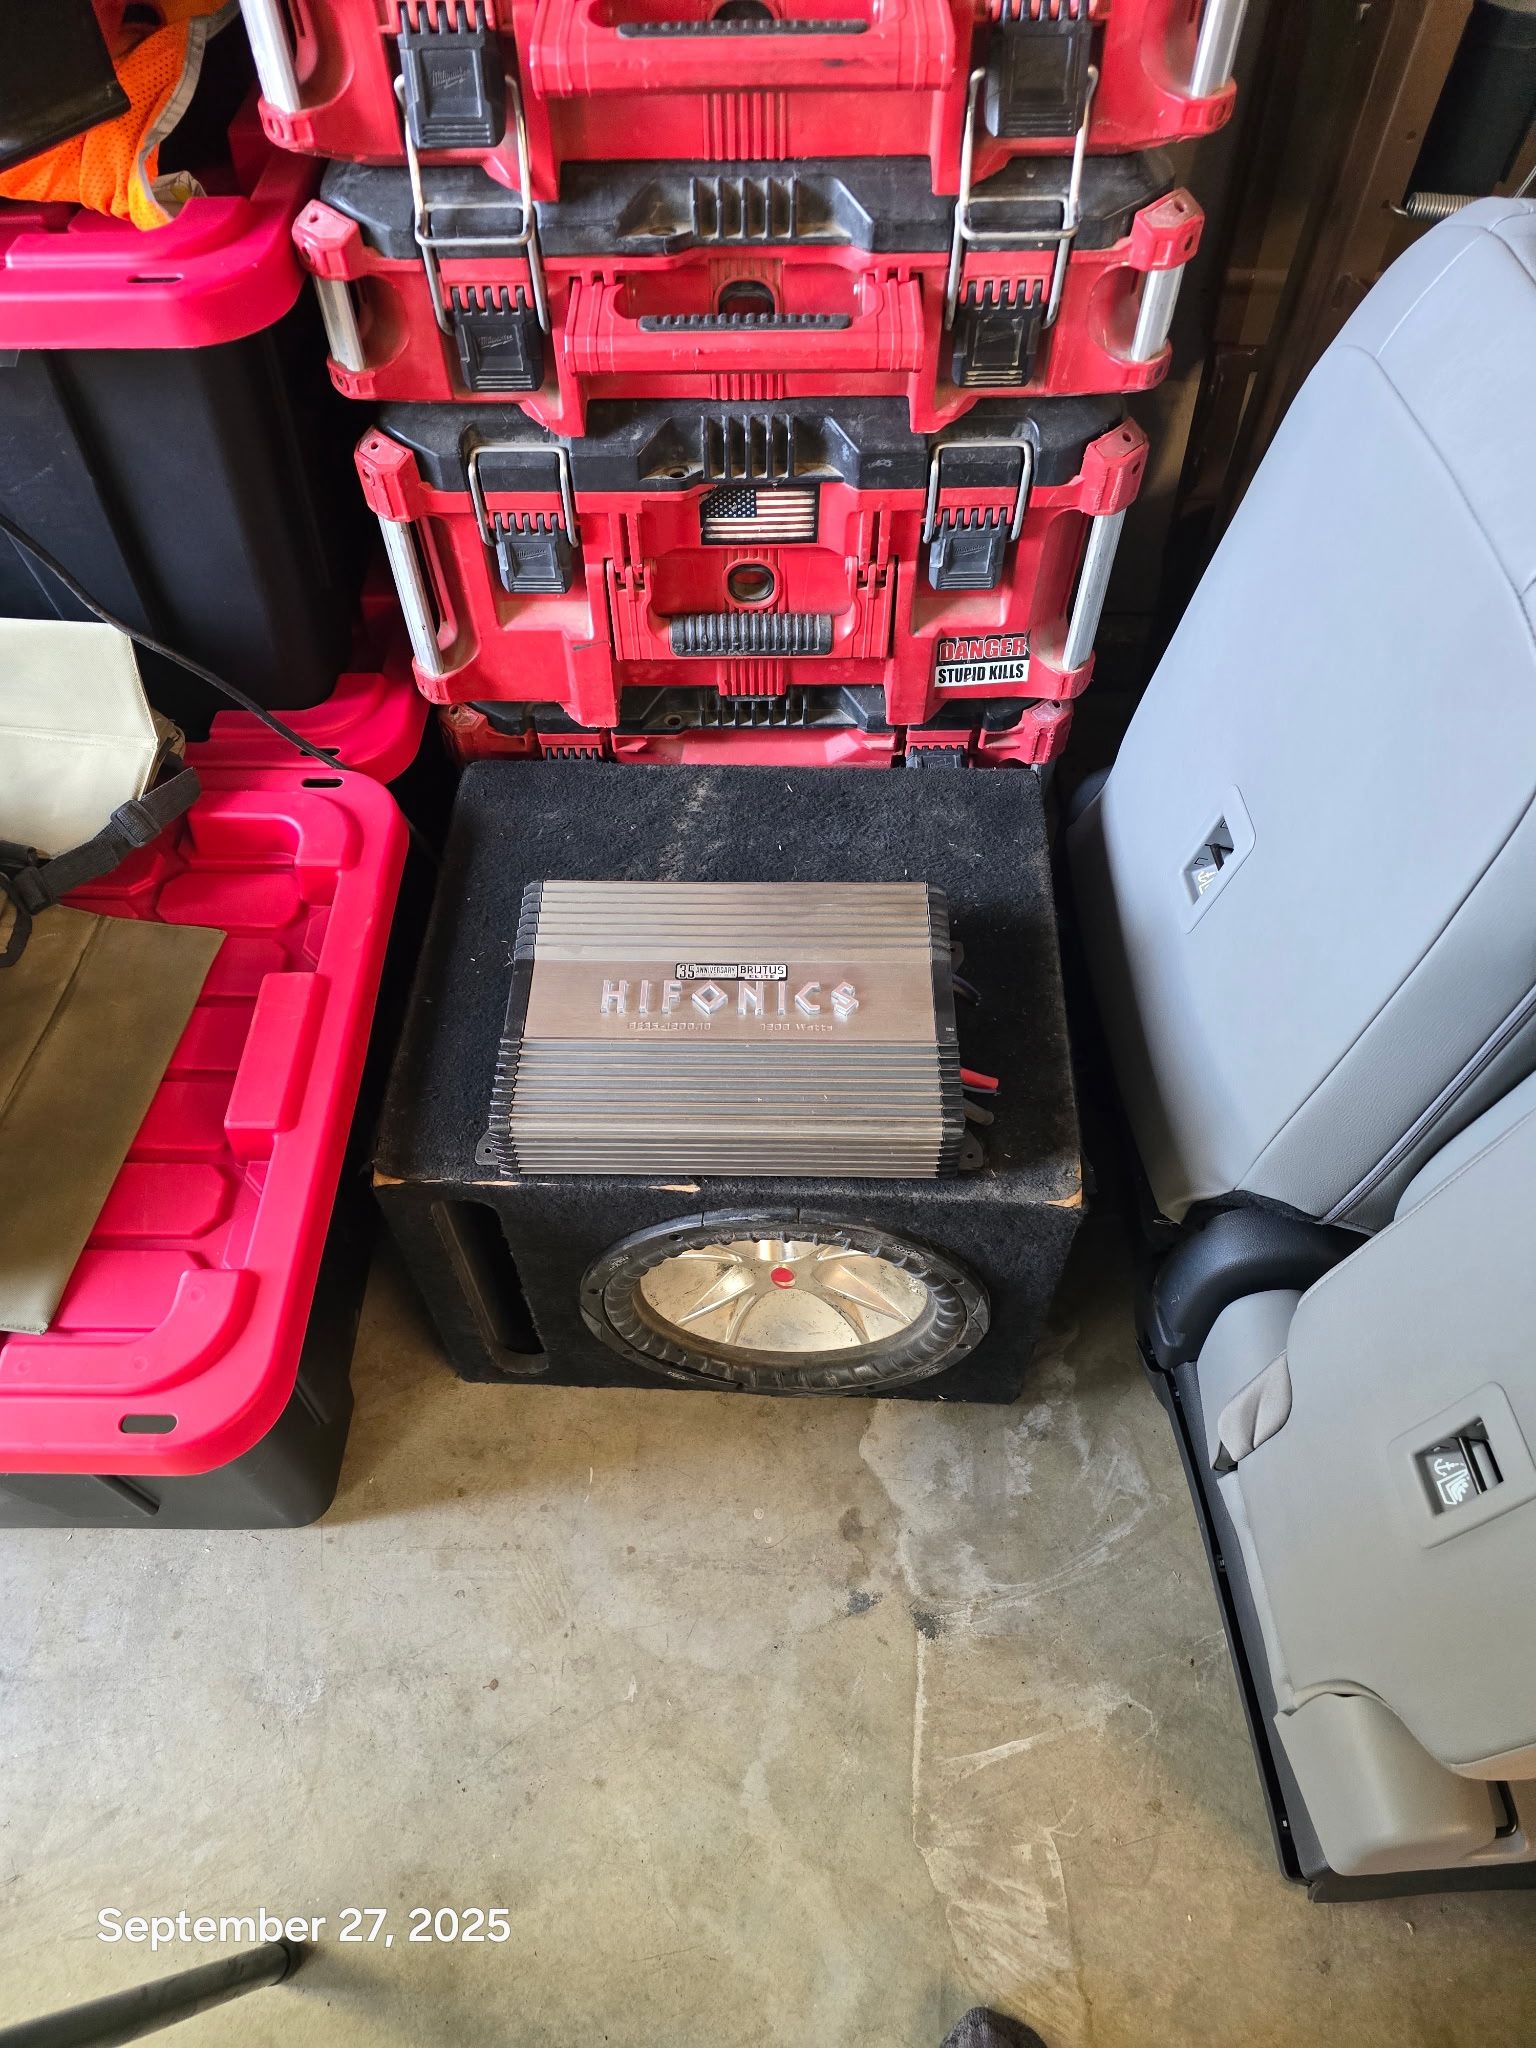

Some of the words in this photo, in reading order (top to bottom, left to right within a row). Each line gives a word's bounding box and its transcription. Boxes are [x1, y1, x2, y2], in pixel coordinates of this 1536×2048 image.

[939, 637, 1027, 662] DANGER
[938, 666, 986, 684] STUPID
[988, 663, 1024, 681] KILLS
[679, 964, 695, 979] 35
[695, 966, 735, 974] ANNIVERSARY
[740, 965, 785, 975] BRUTUS
[600, 980, 860, 1016] HIFONICS
[795, 1023, 834, 1032] Watts
